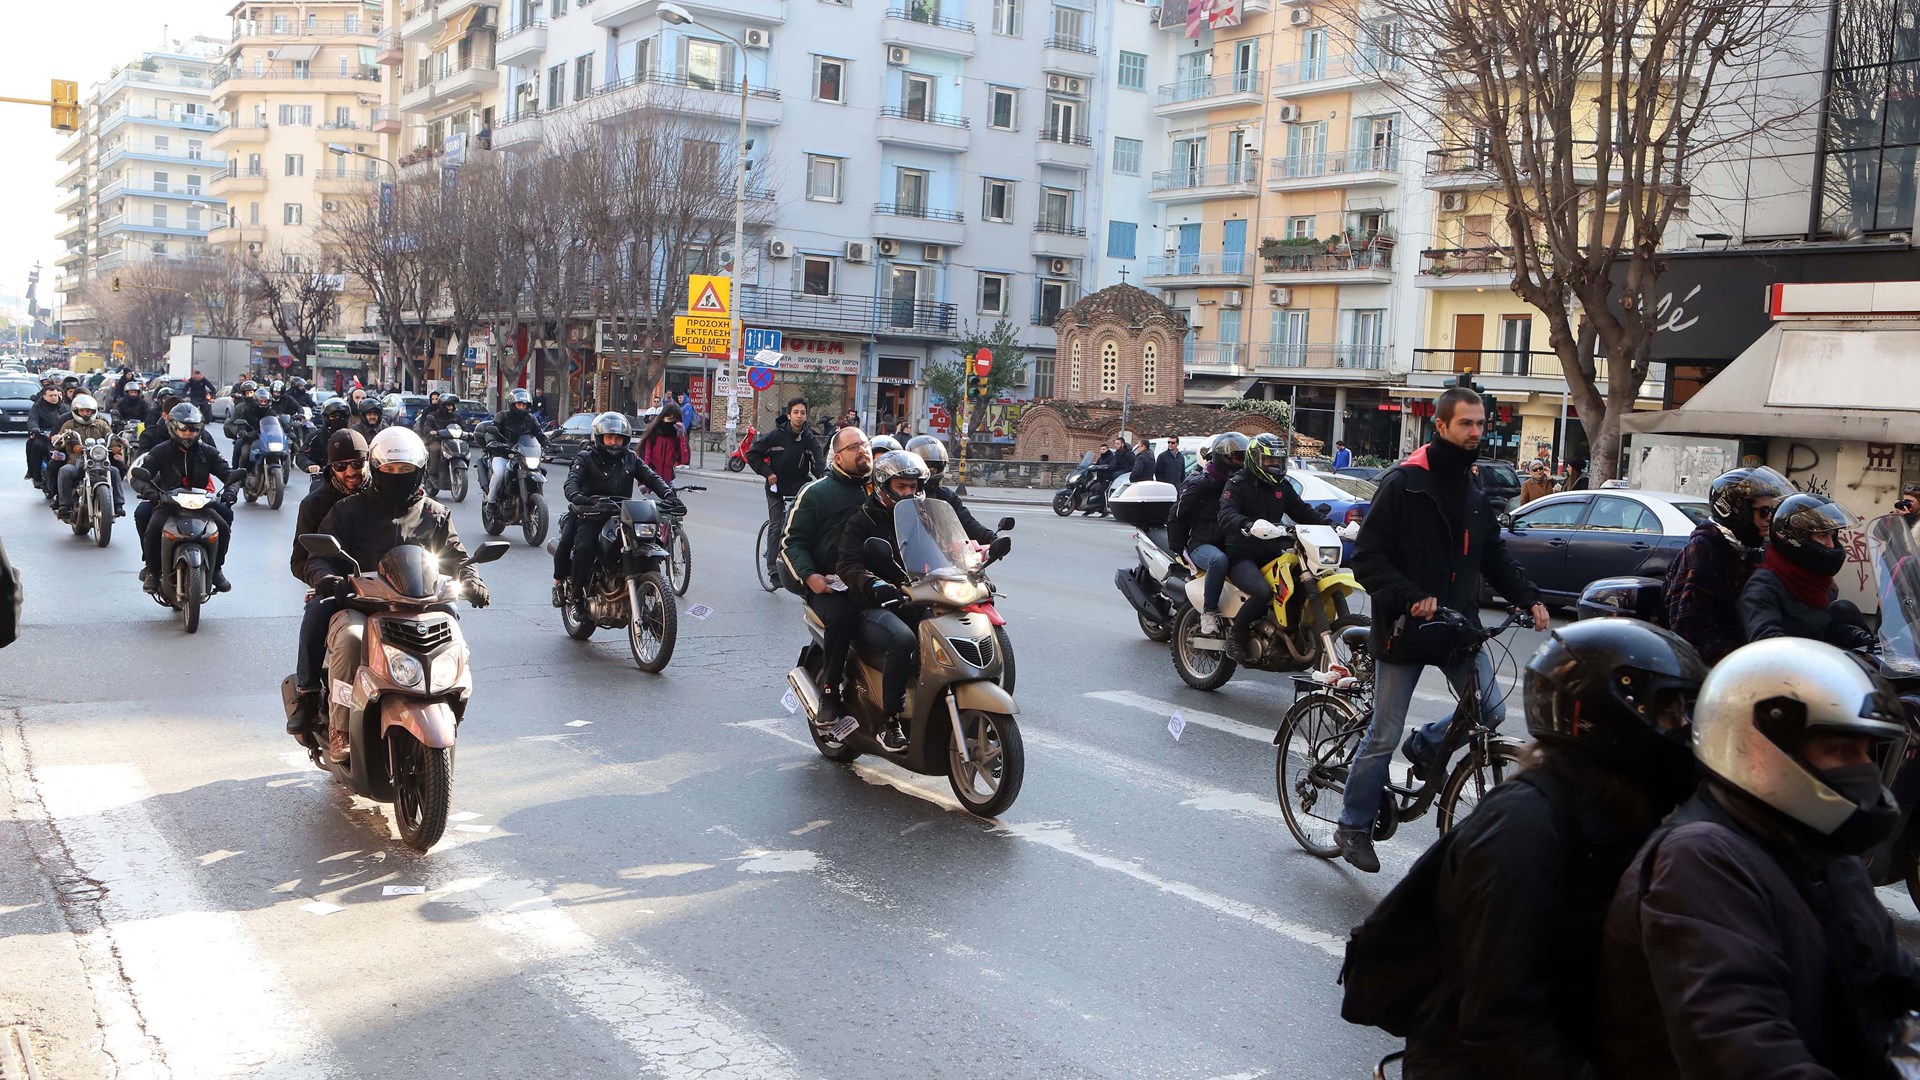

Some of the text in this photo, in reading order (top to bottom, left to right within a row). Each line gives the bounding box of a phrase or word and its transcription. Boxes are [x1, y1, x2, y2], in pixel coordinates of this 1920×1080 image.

[686, 319, 730, 328] ΠΡΟΣΟΧΗ
[685, 328, 731, 337] ΕΚΤΕΛΕΣΗ
[708, 338, 731, 346] ΜΕΤΡ
